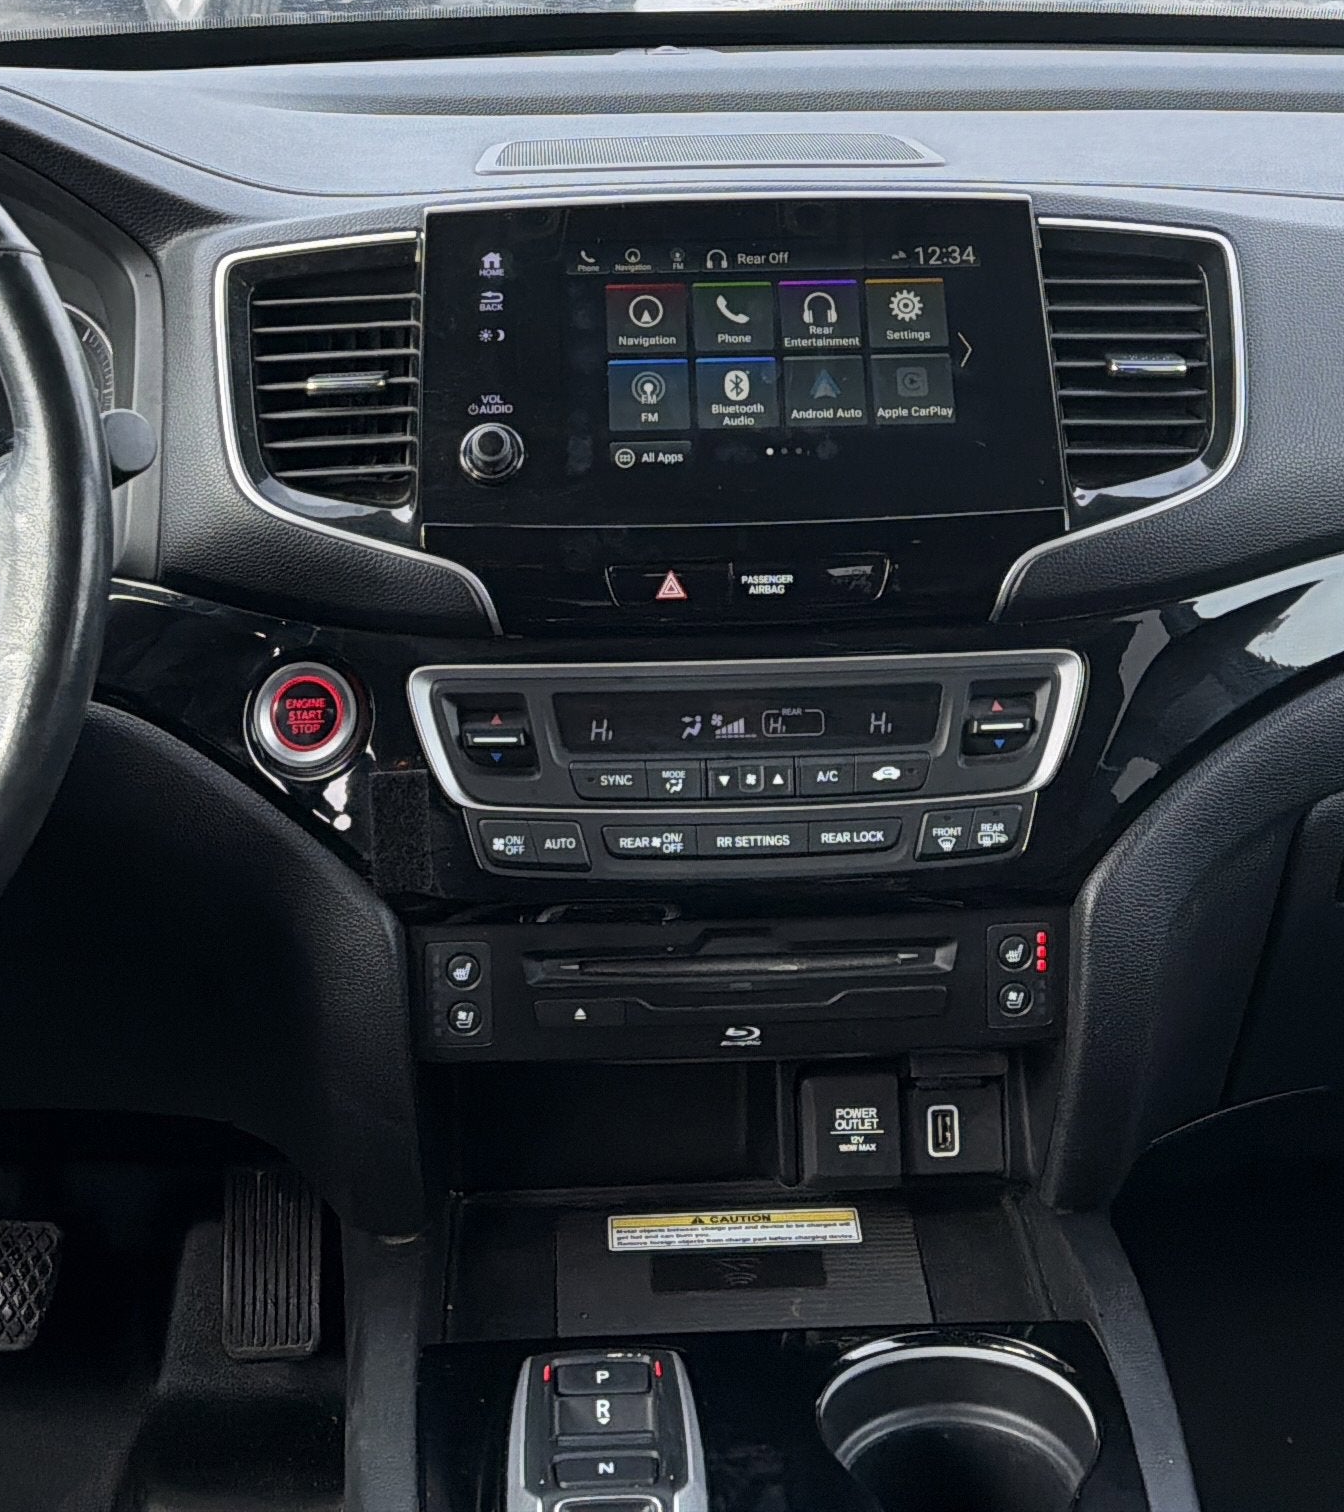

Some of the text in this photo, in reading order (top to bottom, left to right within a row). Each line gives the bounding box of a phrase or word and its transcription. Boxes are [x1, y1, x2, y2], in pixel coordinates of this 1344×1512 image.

[737, 251, 790, 265] Rear Off
[914, 246, 976, 266] 12:34
[577, 264, 600, 273] Phone
[614, 263, 652, 274] Navigation
[672, 262, 684, 271] FM
[479, 268, 504, 277] HOME
[479, 303, 504, 312] BACK
[809, 325, 834, 335] Rear
[886, 330, 931, 341] Settings
[618, 335, 677, 347] Navigation
[717, 333, 752, 343] Phone
[784, 335, 860, 347] Entertainment
[481, 394, 504, 404] VOL
[479, 404, 514, 415] AUDIO
[711, 403, 765, 415] Bluetooth
[791, 408, 862, 420] Android Auto
[877, 405, 953, 420] Apple CarPlay
[641, 413, 659, 423] FM
[723, 415, 755, 426] Audio
[641, 451, 684, 465] All Apps
[741, 575, 794, 584] PASSENGER
[748, 584, 785, 595] AIRBAG
[286, 698, 326, 709] ENGINE
[288, 709, 323, 721] START
[781, 707, 803, 716] REAR
[291, 724, 321, 735] STOP
[662, 770, 686, 779] MODE
[816, 770, 839, 784] A/C
[600, 774, 633, 787] SYNC
[932, 826, 962, 837] FRONT
[980, 823, 1004, 832] REAR
[505, 835, 524, 845] ON/
[619, 836, 650, 849] REAR
[662, 832, 683, 844] ON/
[716, 834, 790, 848] RR SETTINGS
[821, 830, 884, 844] REAR LOCK
[544, 838, 576, 850] AUTO
[662, 843, 684, 854] OFF
[505, 845, 525, 855] OFF
[835, 1107, 878, 1119] POWER
[834, 1118, 879, 1130] OUTLET
[858, 1143, 877, 1152] MAX
[709, 1213, 771, 1224] CAUTION
[794, 1233, 827, 1241] charging
[595, 1370, 610, 1384] P
[596, 1399, 611, 1418] R
[598, 1462, 615, 1475] N
